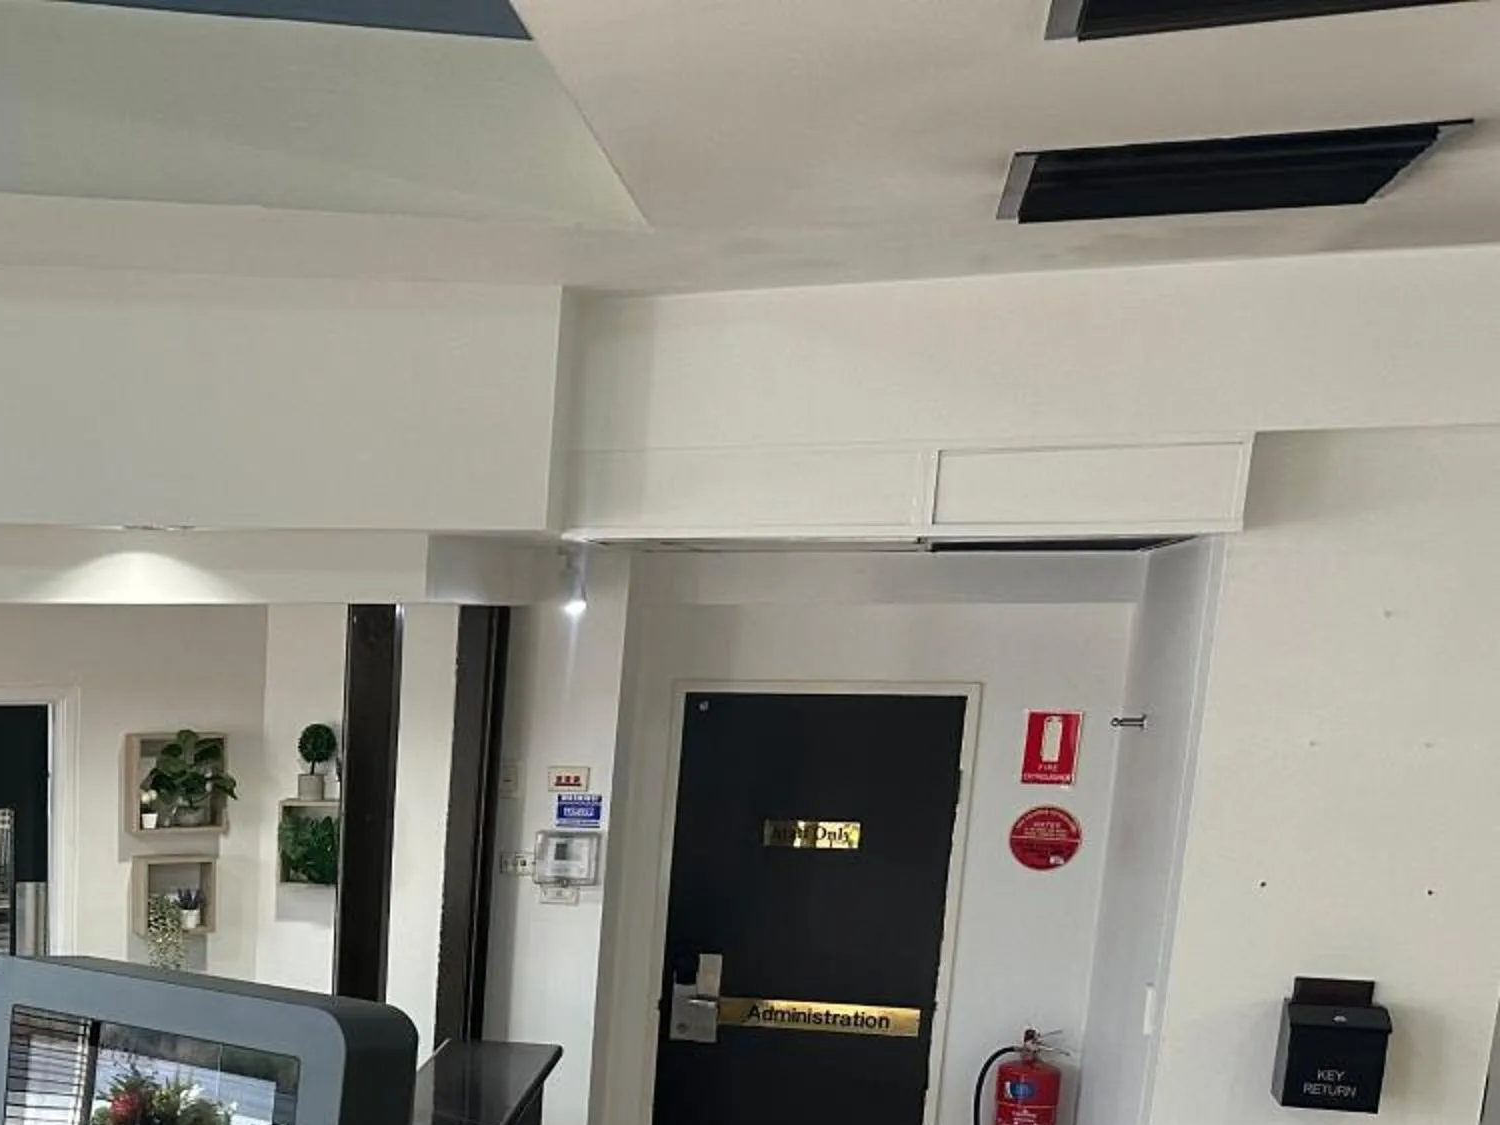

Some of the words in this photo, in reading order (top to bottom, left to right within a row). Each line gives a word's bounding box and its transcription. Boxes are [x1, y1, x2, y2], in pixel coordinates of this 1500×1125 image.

[1037, 764, 1059, 772] FIRE
[747, 1004, 890, 1029] Administration
[1317, 1068, 1345, 1082] KEY
[1303, 1082, 1357, 1098] RETURN
